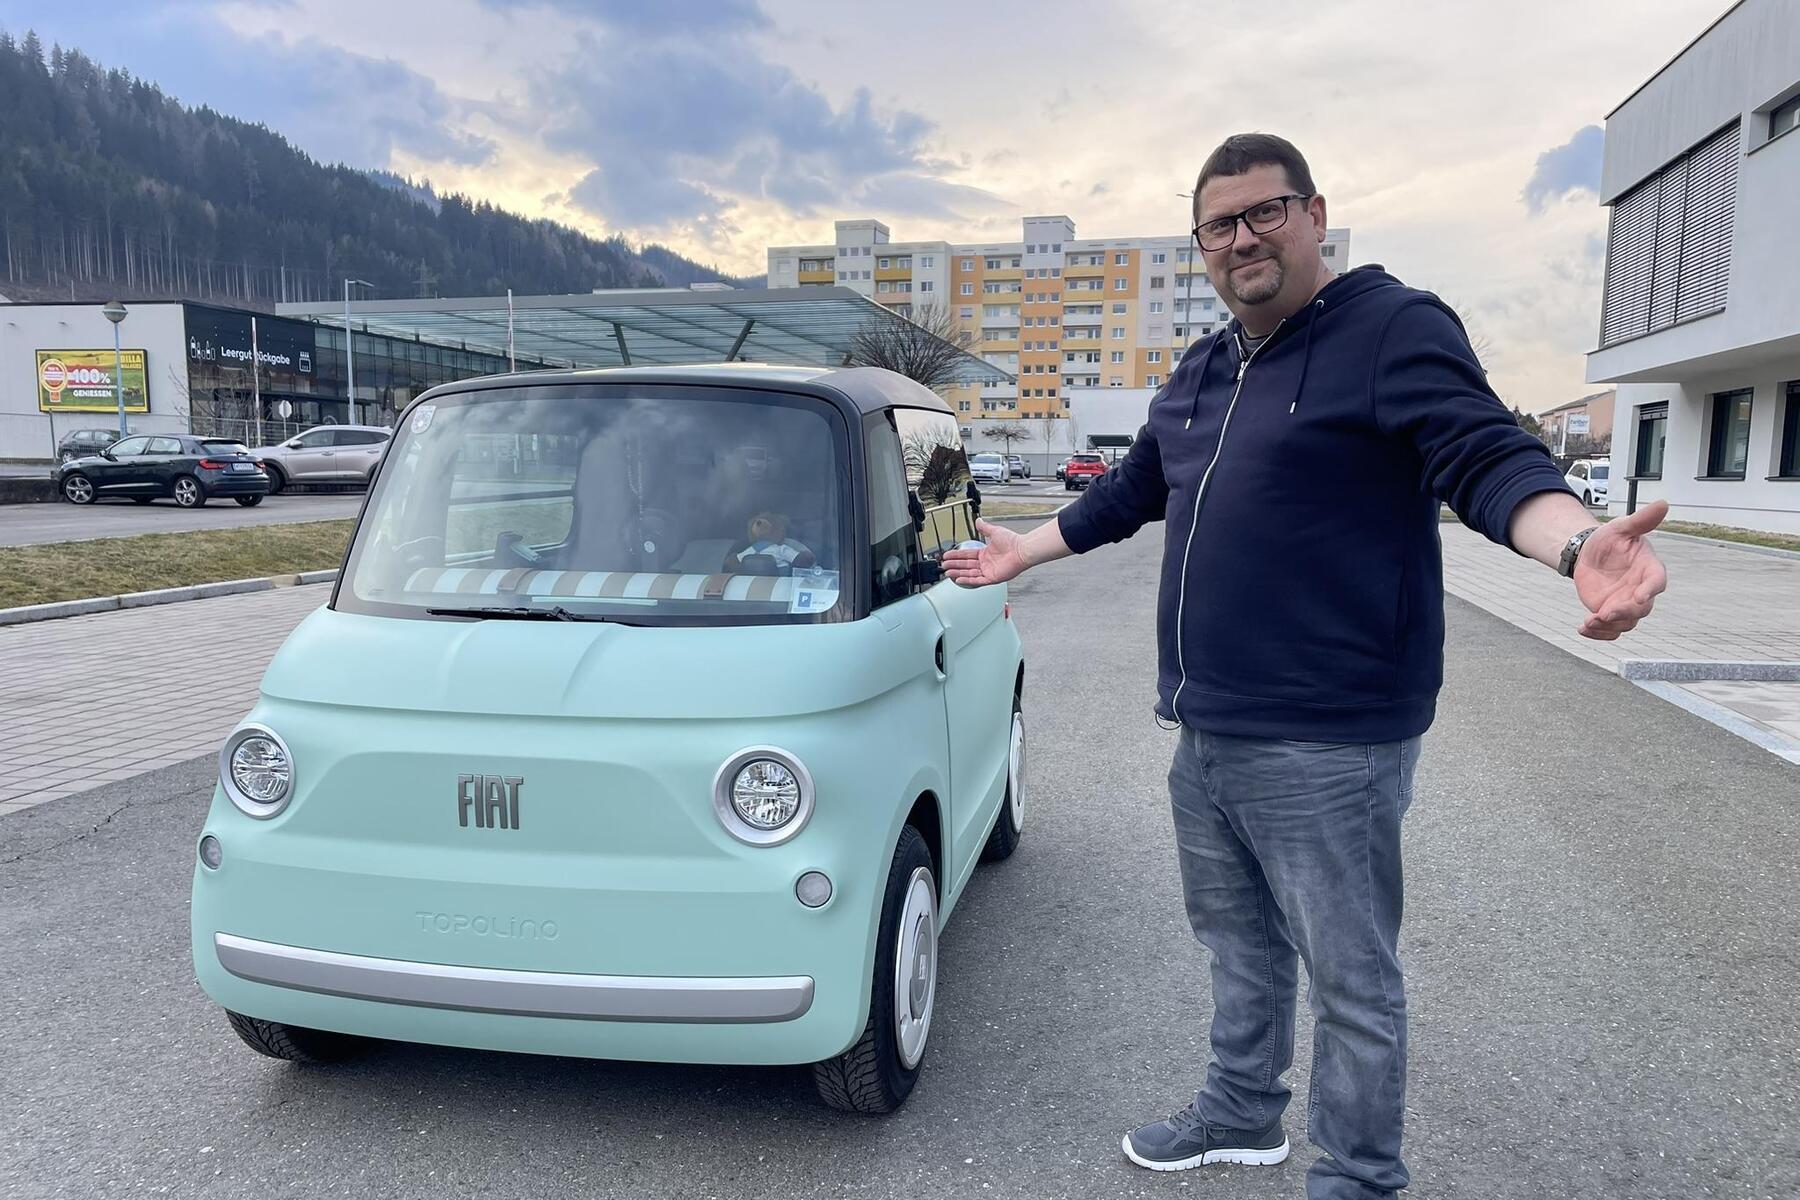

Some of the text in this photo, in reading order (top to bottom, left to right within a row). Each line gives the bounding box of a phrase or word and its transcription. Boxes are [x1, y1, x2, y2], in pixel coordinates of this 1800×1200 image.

[221, 346, 252, 361] Leergut
[72, 368, 111, 384] 100%
[72, 389, 112, 397] GENIESSEN
[457, 773, 524, 830] FIAT
